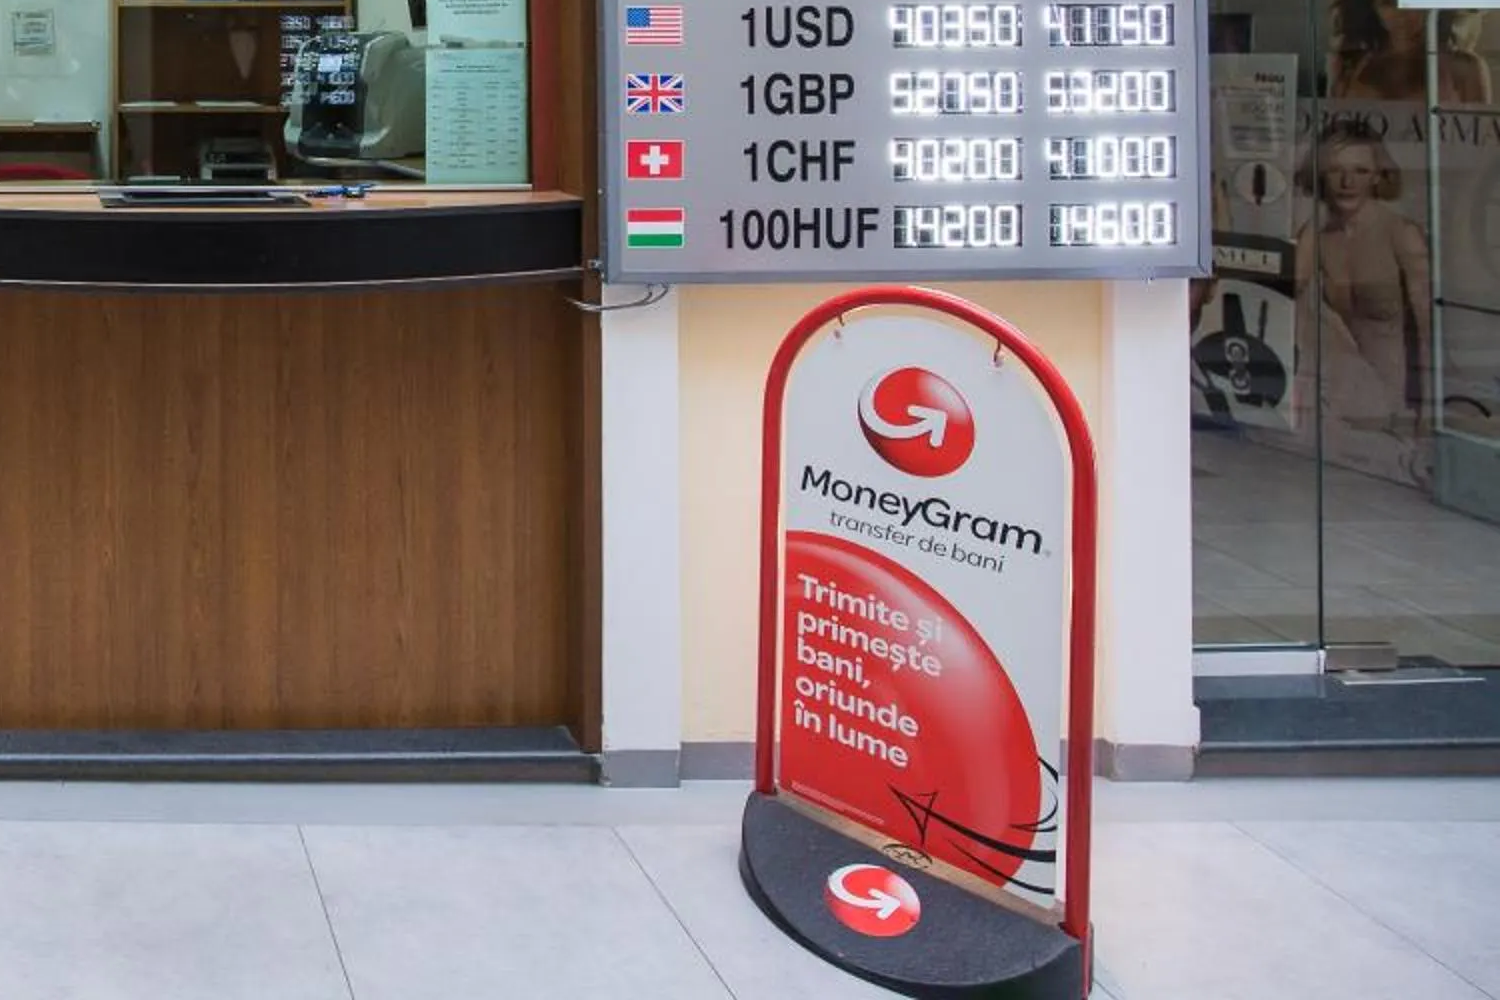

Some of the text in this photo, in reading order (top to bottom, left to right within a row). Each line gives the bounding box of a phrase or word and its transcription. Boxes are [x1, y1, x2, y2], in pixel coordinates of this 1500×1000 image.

[740, 6, 855, 49] 1USD
[739, 72, 855, 116] 1GBP
[743, 140, 856, 183] 1CHF
[719, 207, 880, 251] 100HUF
[800, 465, 1043, 554] MoneyGram
[829, 511, 1005, 574] transfer de bani
[798, 573, 910, 632] Trimite
[797, 636, 871, 689] bani,
[794, 699, 909, 768] în lume
[795, 675, 919, 738] oriunde
